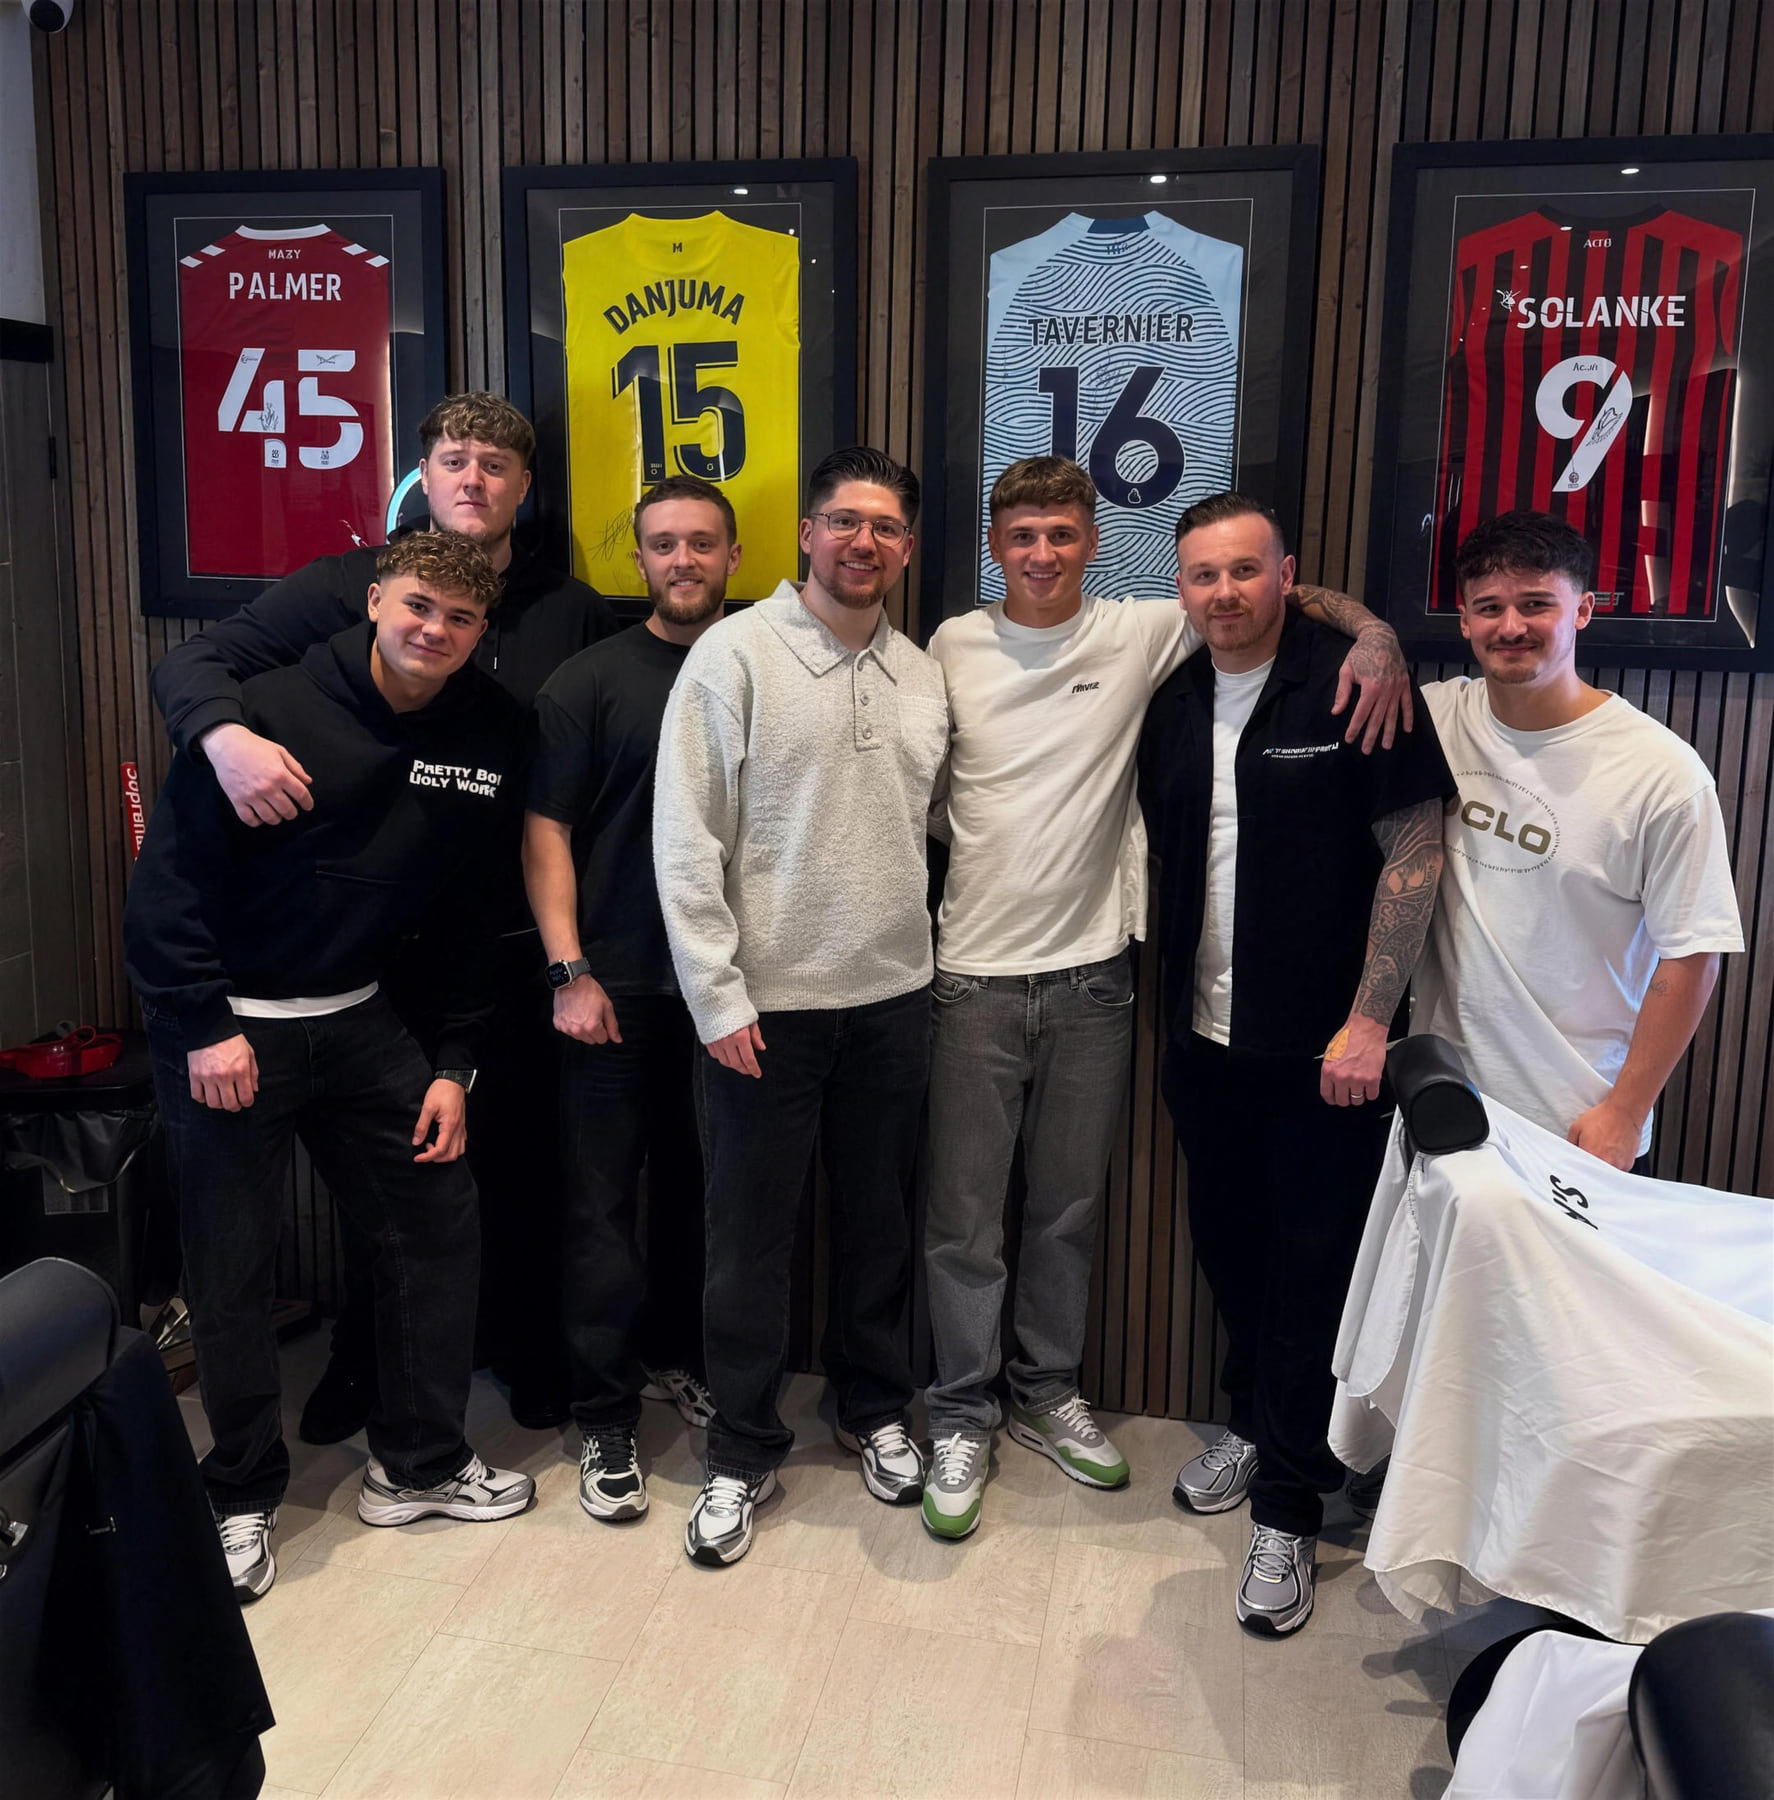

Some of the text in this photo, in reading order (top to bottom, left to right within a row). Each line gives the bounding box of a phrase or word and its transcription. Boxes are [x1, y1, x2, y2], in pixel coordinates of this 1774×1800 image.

[229, 271, 342, 301] PALMER
[603, 279, 745, 335] DANJUMA
[1027, 313, 1194, 347] TAVERNIER
[1516, 294, 1687, 329] SOLANKE
[217, 347, 364, 470] 45
[611, 340, 746, 486] 15
[1037, 366, 1185, 511] 16
[1535, 354, 1633, 493] 9
